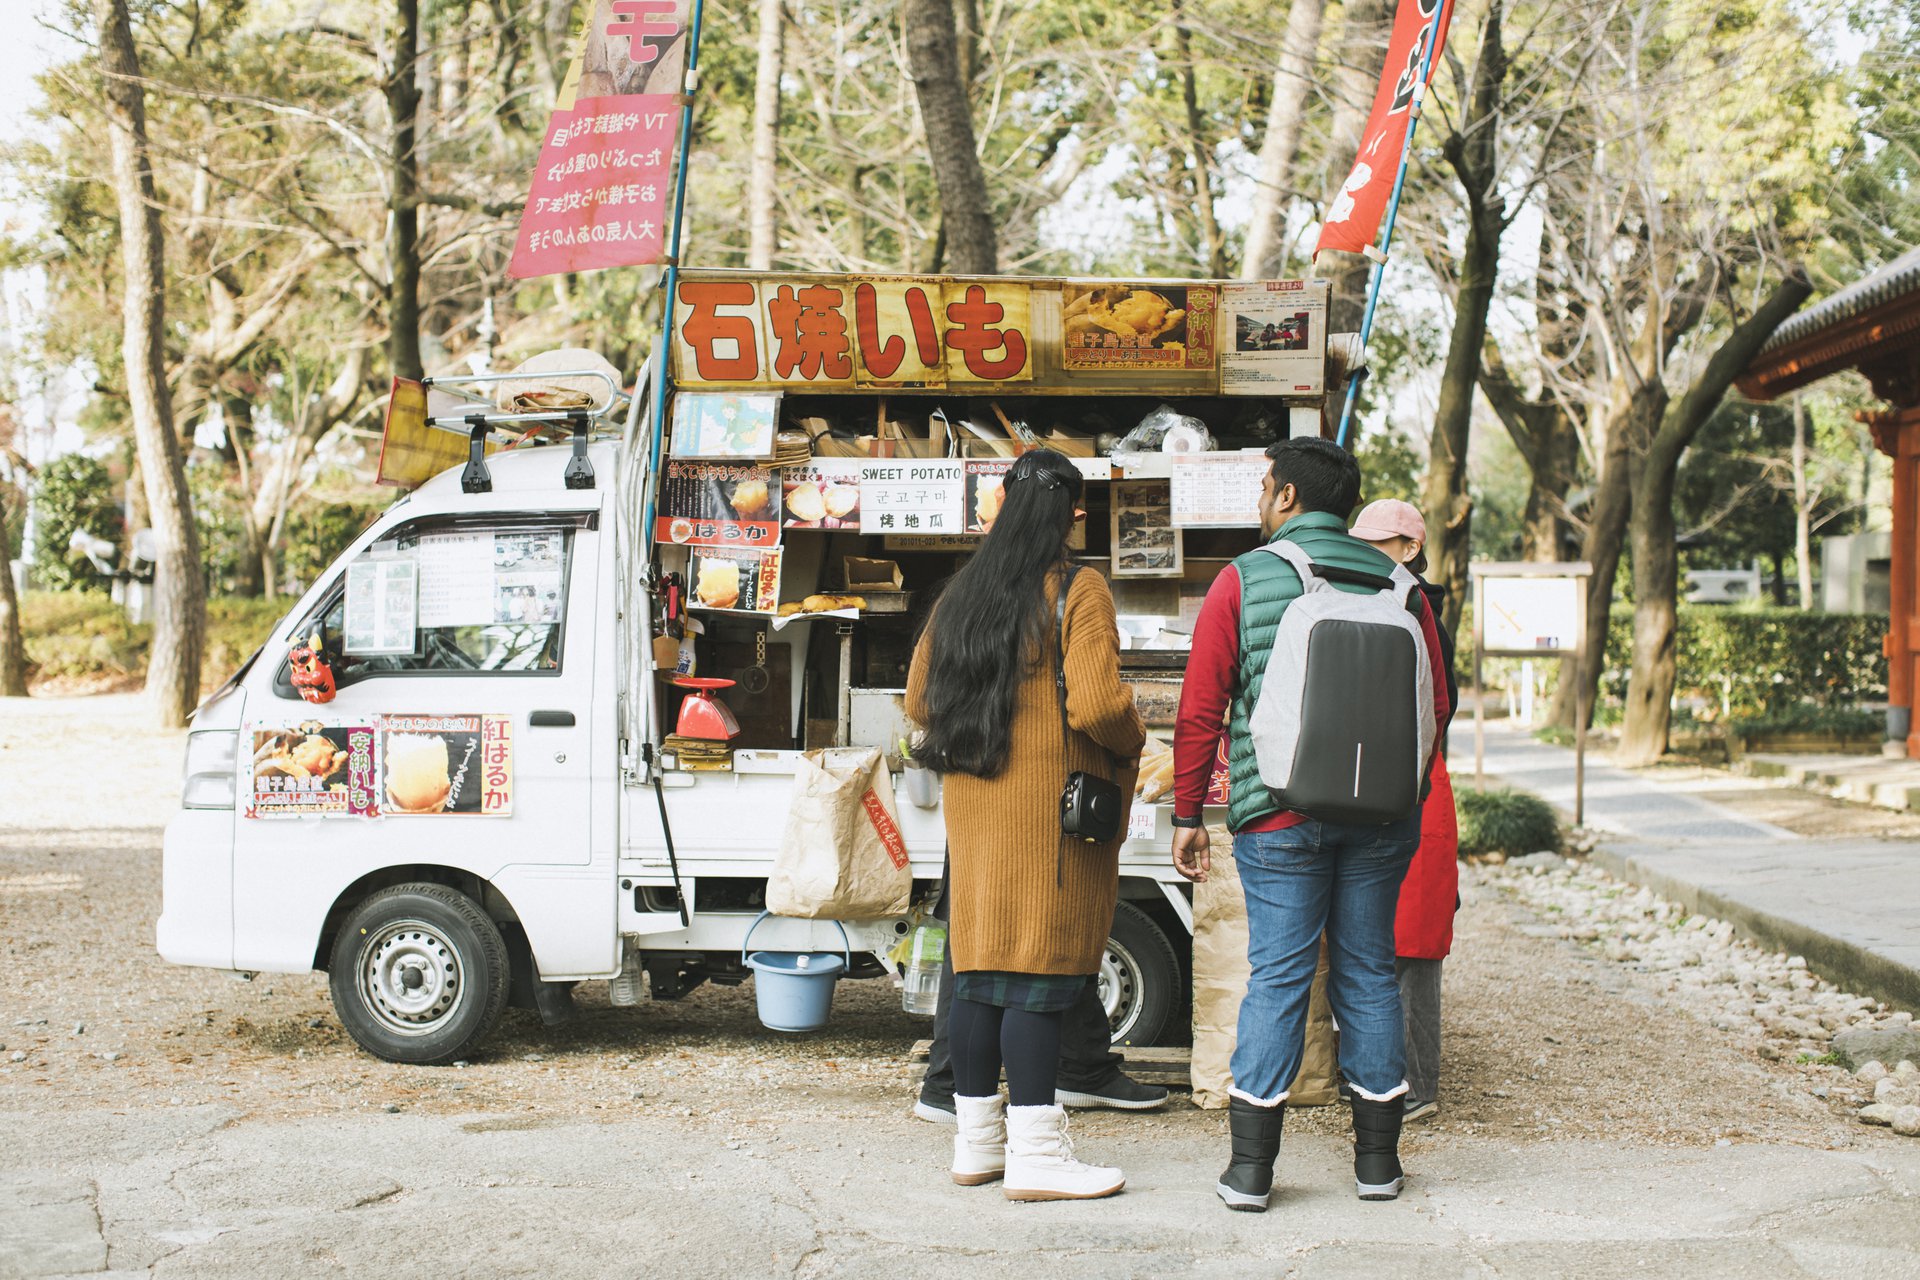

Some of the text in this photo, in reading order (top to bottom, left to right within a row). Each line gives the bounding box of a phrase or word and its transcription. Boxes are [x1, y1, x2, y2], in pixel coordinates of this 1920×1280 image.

[678, 281, 1028, 381] 石焼いも
[1187, 288, 1214, 367] 安納いも
[669, 461, 772, 483] 甘くてもちもちの食感
[862, 467, 961, 480] SWEET POTATO
[875, 490, 948, 505] 군고구마
[880, 513, 944, 528] 烤地瓜
[349, 732, 371, 808] 安納いも
[483, 718, 510, 809] 紅はるか
